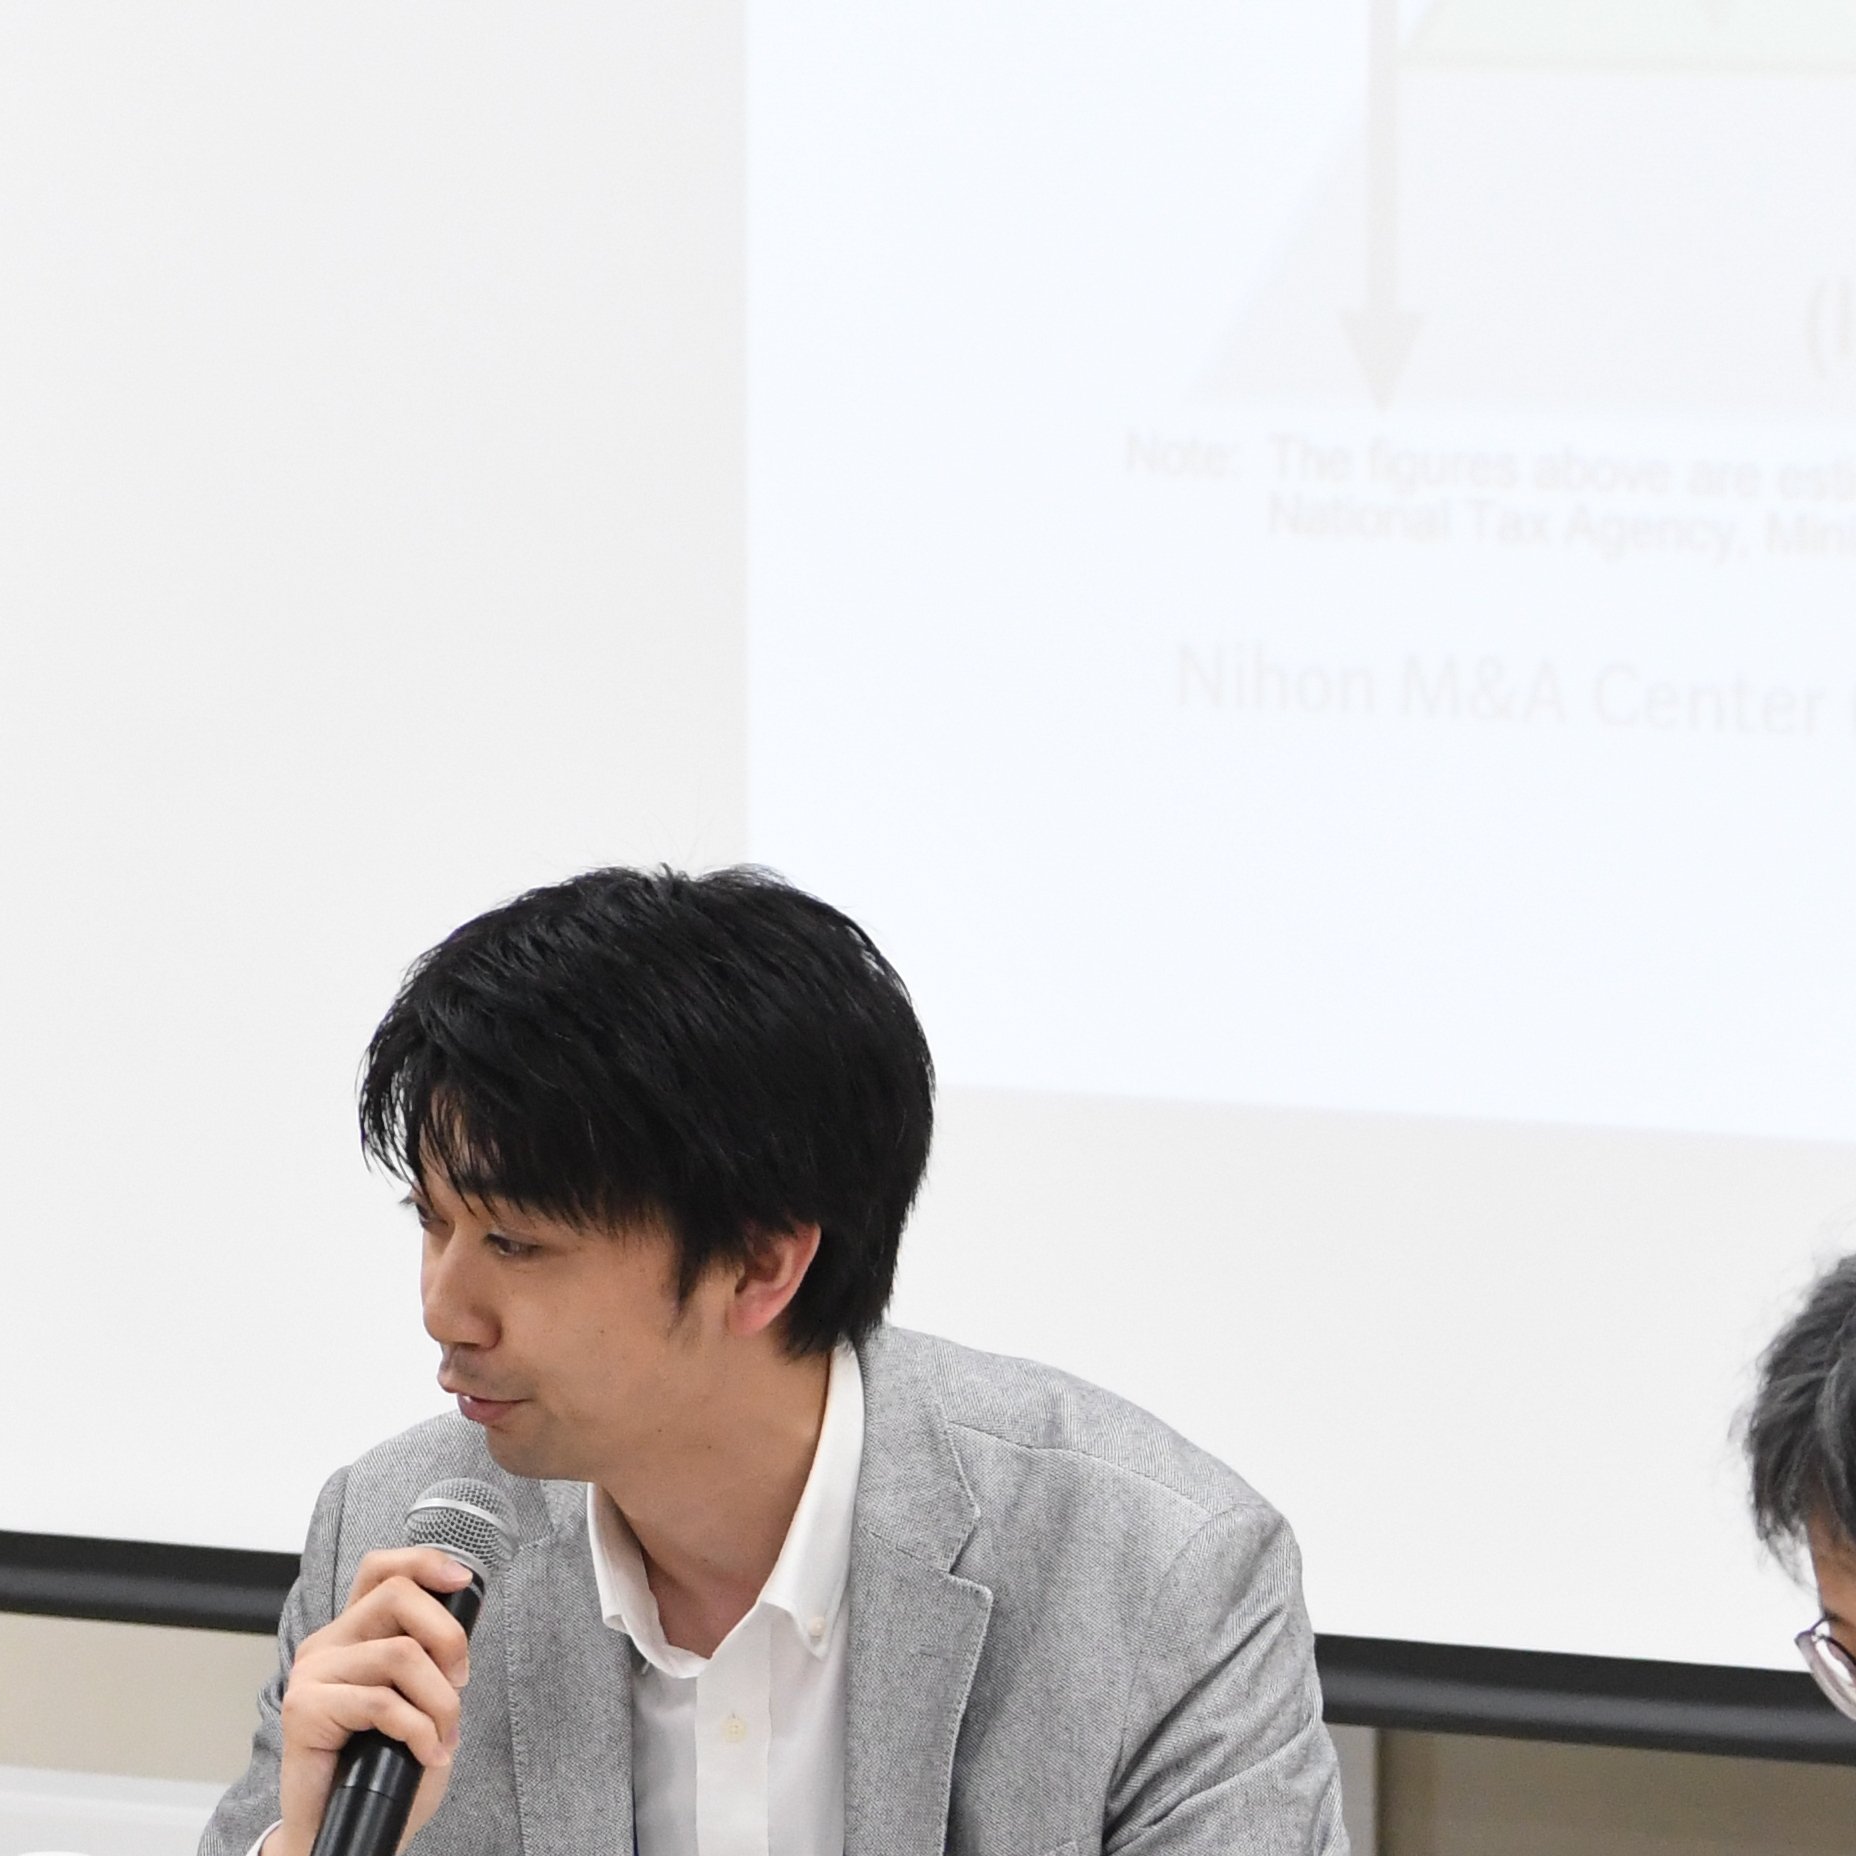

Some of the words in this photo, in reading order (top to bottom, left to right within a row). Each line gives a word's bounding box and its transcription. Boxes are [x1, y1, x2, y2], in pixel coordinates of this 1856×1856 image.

[1124, 427, 1242, 481] Note:
[1267, 430, 1353, 484] The
[1368, 434, 1520, 492] figures
[1532, 443, 1672, 495] above
[1685, 456, 1762, 497] are
[1266, 492, 1455, 543] National
[1467, 496, 1553, 550] Tax
[1562, 499, 1748, 566] Agency,
[1175, 635, 1376, 715] Nihon
[1398, 650, 1567, 726] M&A
[1591, 657, 1827, 738] Center
